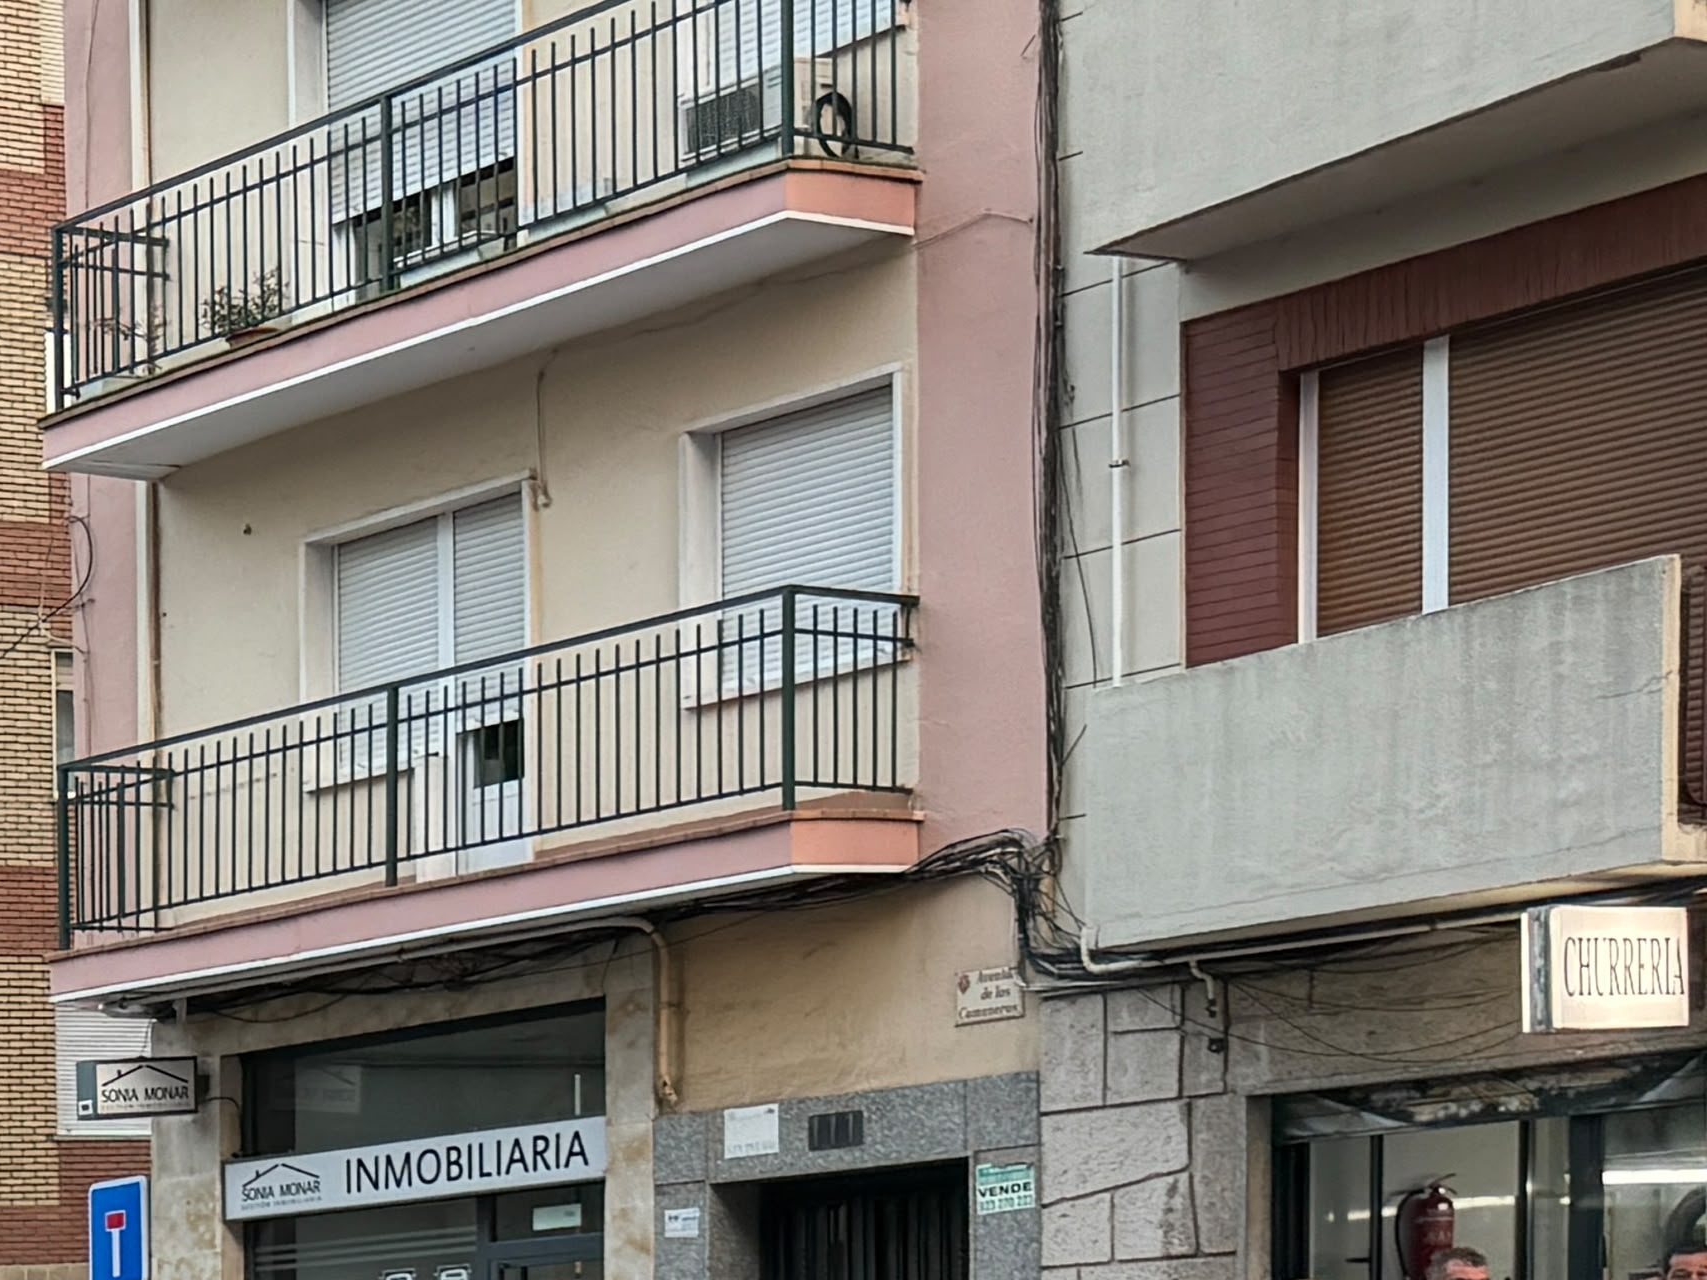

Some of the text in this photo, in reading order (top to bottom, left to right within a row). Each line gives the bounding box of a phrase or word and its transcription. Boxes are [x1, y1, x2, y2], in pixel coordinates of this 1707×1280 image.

[1563, 936, 1686, 998] CHURRERIA
[101, 1086, 190, 1103] SONIA MONAR
[345, 1130, 590, 1194] INMOBILIARIA
[241, 1180, 321, 1202] SONIA MONAR
[978, 1182, 1032, 1198] VENDE
